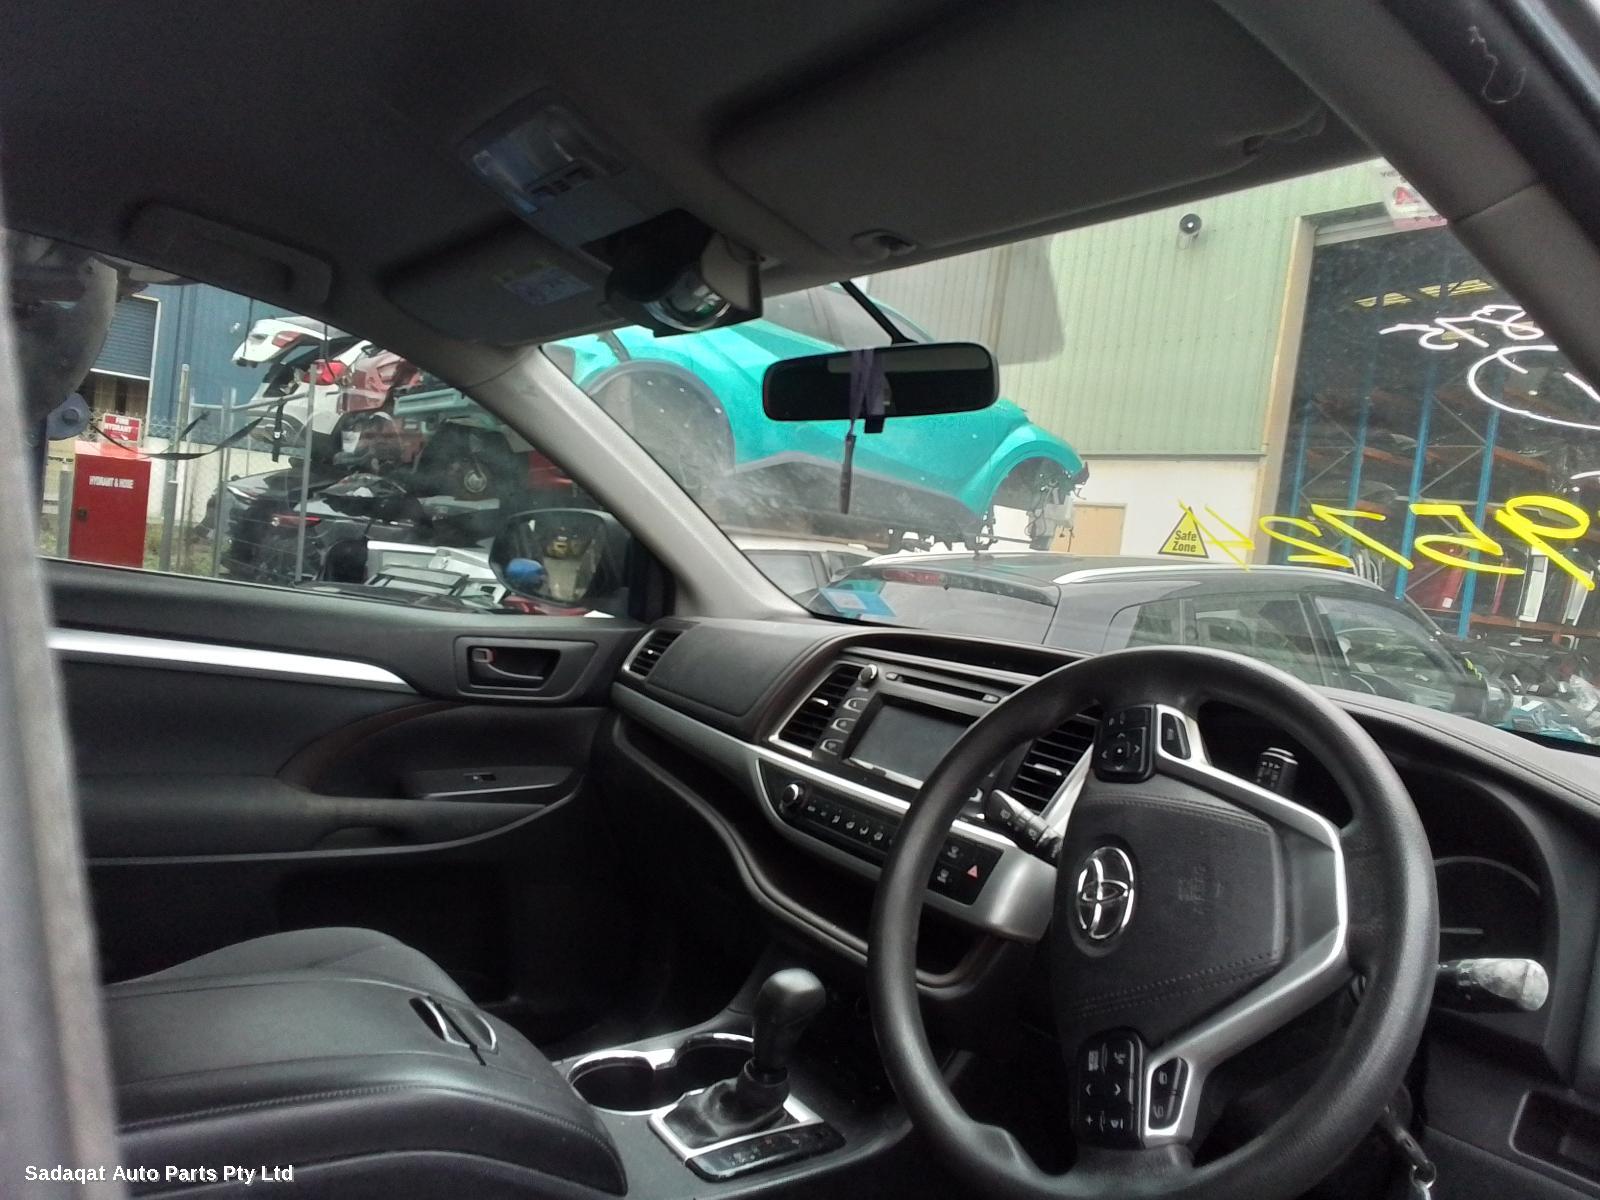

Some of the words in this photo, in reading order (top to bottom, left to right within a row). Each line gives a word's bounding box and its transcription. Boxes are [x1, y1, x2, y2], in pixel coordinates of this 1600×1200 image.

[89, 475, 114, 487] HYDRANT
[114, 478, 118, 487] &
[1174, 530, 1197, 542] Safe
[1172, 540, 1197, 553] Zone
